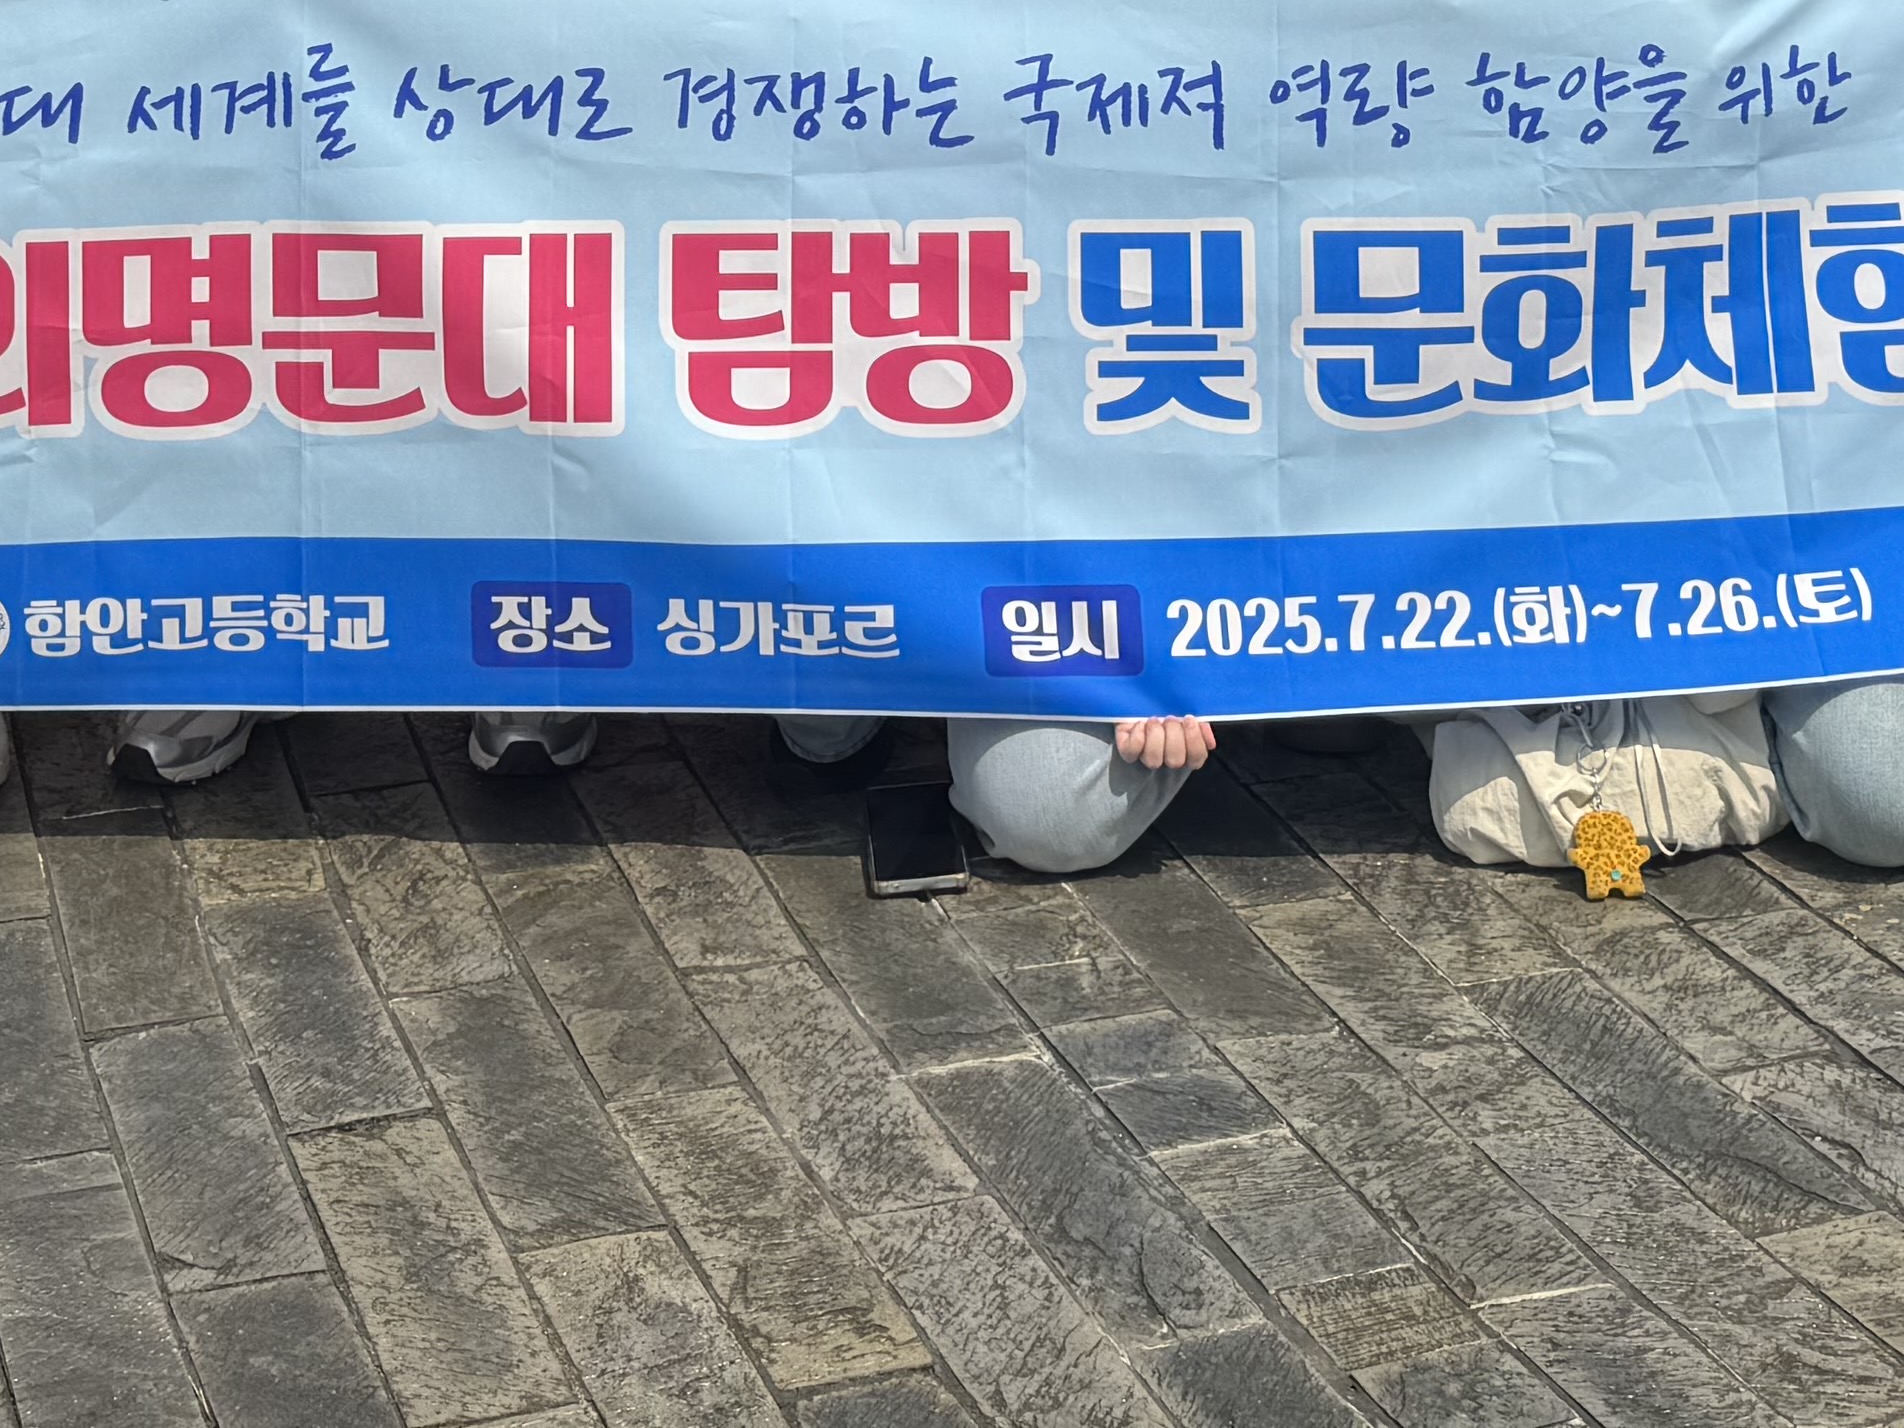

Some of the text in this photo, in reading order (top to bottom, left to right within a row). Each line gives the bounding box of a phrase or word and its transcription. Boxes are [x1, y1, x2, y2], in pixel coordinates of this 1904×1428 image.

[128, 43, 355, 161] 세계를
[394, 66, 634, 142] 상대로
[663, 56, 975, 149] 경쟁하는
[1003, 52, 1225, 155] 국제적
[1269, 60, 1433, 149] 역량
[1464, 44, 1689, 153] 함양을
[1718, 45, 1853, 125] 위한
[671, 230, 1030, 427] 탐방
[1079, 230, 1251, 422] 및
[23, 593, 390, 657] 함안고등학교
[490, 596, 612, 654] 장소
[657, 598, 900, 659] 싱가포르
[1001, 599, 1120, 663] 일시
[1166, 567, 1873, 658] 2025.7.22.(화)~7.26.(토)
